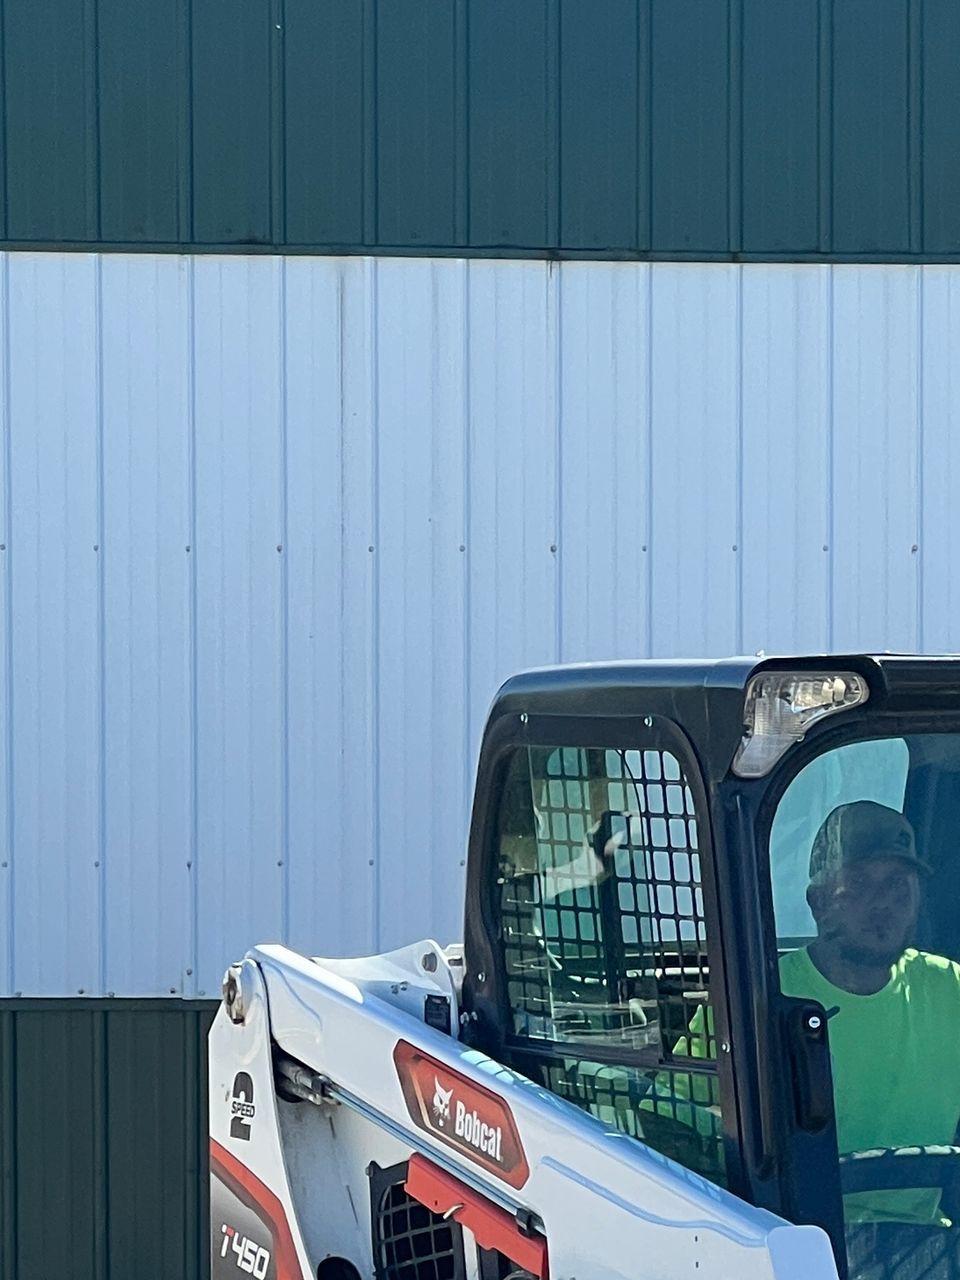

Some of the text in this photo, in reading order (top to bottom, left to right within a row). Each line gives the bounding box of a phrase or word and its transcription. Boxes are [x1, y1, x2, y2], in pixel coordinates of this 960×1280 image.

[230, 1071, 254, 1141] 2
[231, 1101, 255, 1118] SPEED
[455, 1100, 501, 1161] Bobcat
[220, 1224, 270, 1280] T450
